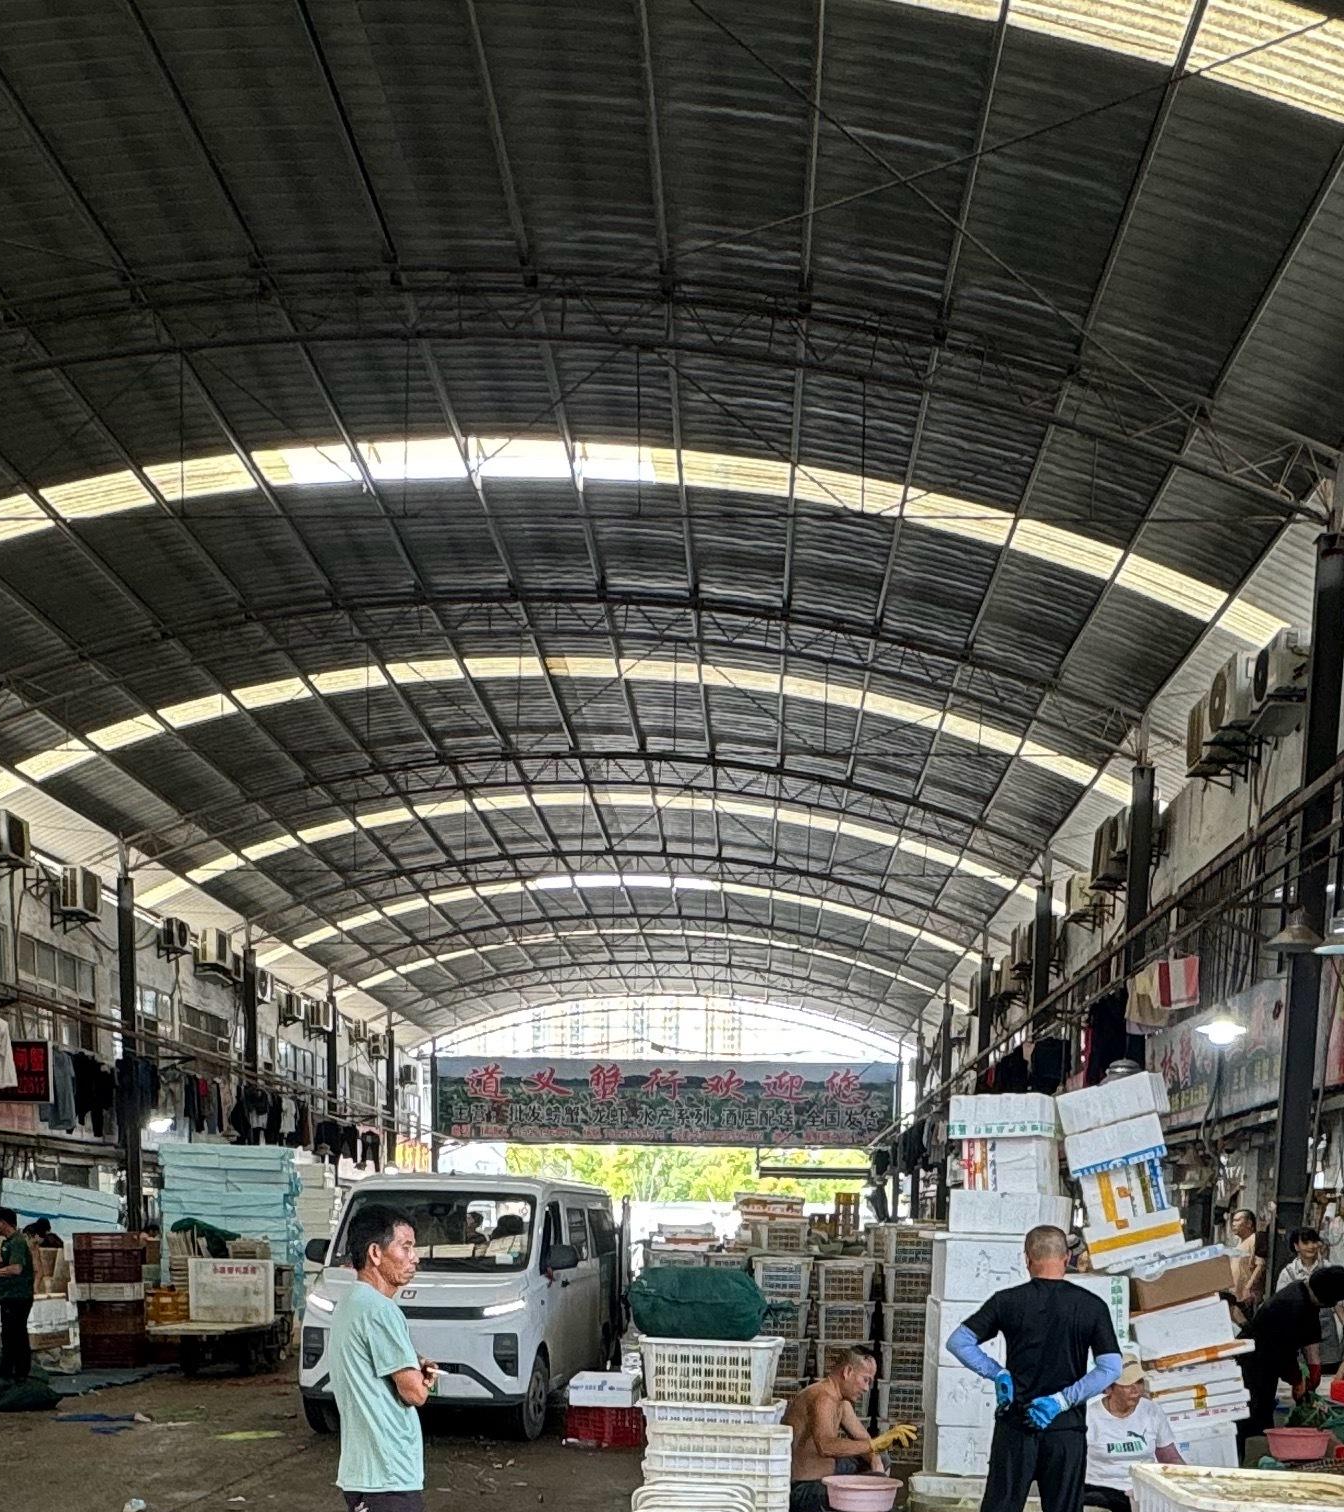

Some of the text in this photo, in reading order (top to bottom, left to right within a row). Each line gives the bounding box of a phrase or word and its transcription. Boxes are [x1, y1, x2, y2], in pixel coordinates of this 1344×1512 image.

[464, 1062, 872, 1107] 道义蟹行欢迎您
